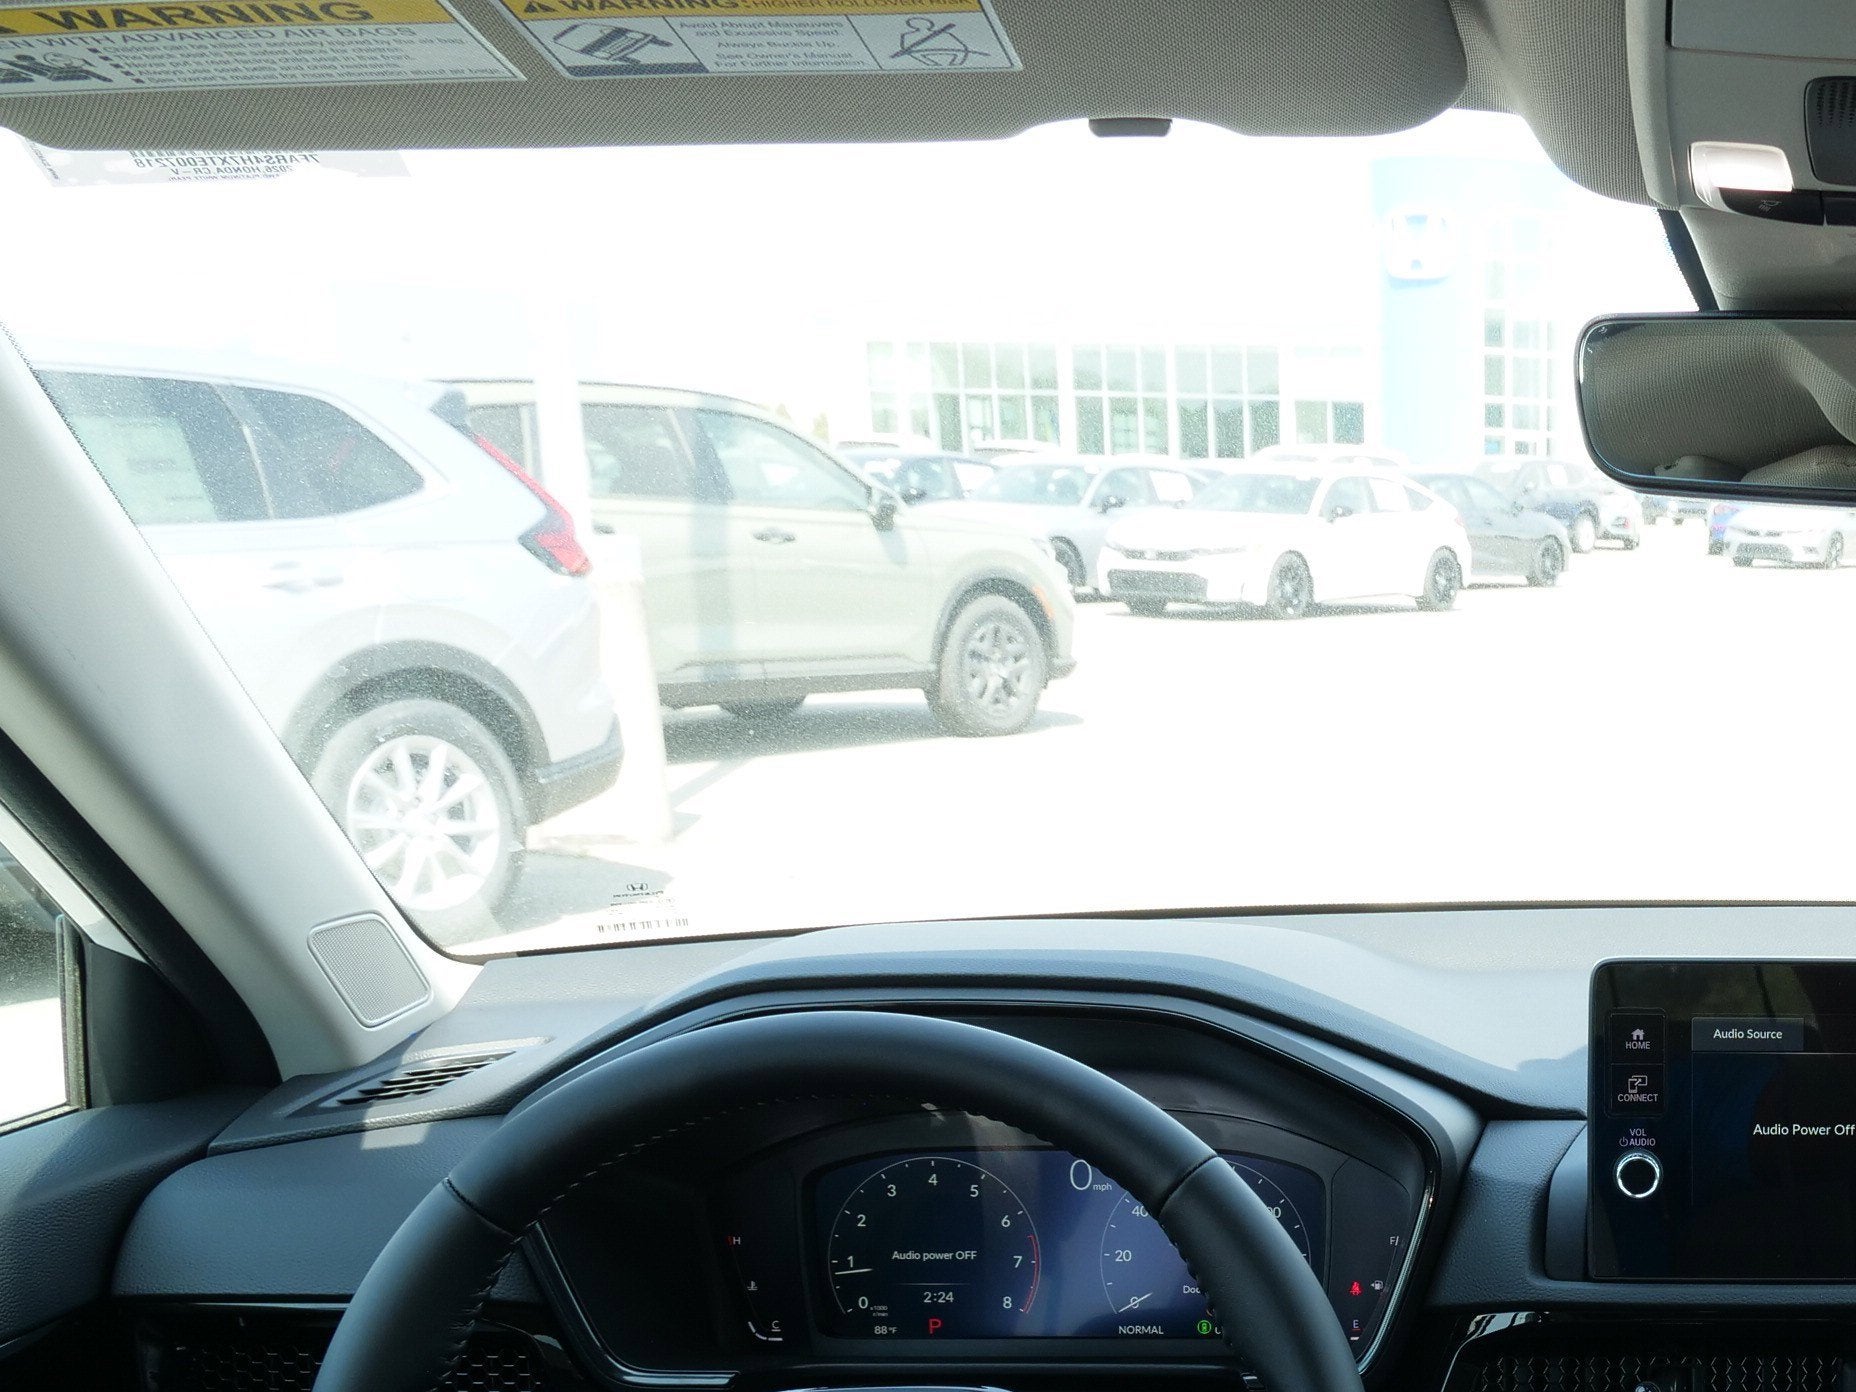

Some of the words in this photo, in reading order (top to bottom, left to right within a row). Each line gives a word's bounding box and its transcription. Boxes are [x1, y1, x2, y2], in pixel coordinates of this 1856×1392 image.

[33, 1, 374, 31] WARNING
[36, 35, 115, 47] WITH
[122, 29, 276, 44] ADVANCED
[284, 28, 333, 38] AIR
[337, 26, 418, 37] BAGS
[1713, 1028, 1743, 1039] Audio
[1746, 1028, 1783, 1039] Source
[1625, 1041, 1651, 1050] HOME
[1617, 1093, 1659, 1103] CONNECT
[1629, 1128, 1647, 1137] VOL
[1753, 1123, 1789, 1136] Audio
[1793, 1124, 1830, 1136] Power
[1834, 1123, 1856, 1136] Off
[1629, 1137, 1656, 1147] AUDIO
[928, 1173, 938, 1186] 4
[1069, 1159, 1093, 1191] 0
[887, 1184, 897, 1197] 3
[970, 1184, 979, 1198] 5
[1092, 1181, 1112, 1192] mph
[1131, 1205, 1149, 1218] 40
[857, 1214, 867, 1227] 2
[1001, 1215, 1011, 1228] 6
[733, 1236, 741, 1245] H
[847, 1255, 854, 1268] 1
[891, 1250, 921, 1260] Audio
[922, 1251, 954, 1262] power
[955, 1250, 978, 1260] OFF
[1013, 1256, 1023, 1269] 7
[1115, 1250, 1132, 1262] 20
[858, 1296, 869, 1309] 0
[923, 1291, 954, 1304] 2:24
[1002, 1296, 1012, 1309] 8
[772, 1320, 780, 1329] C
[928, 1318, 942, 1335] P
[1118, 1325, 1164, 1335] NORMAL
[1353, 1320, 1360, 1329] E
